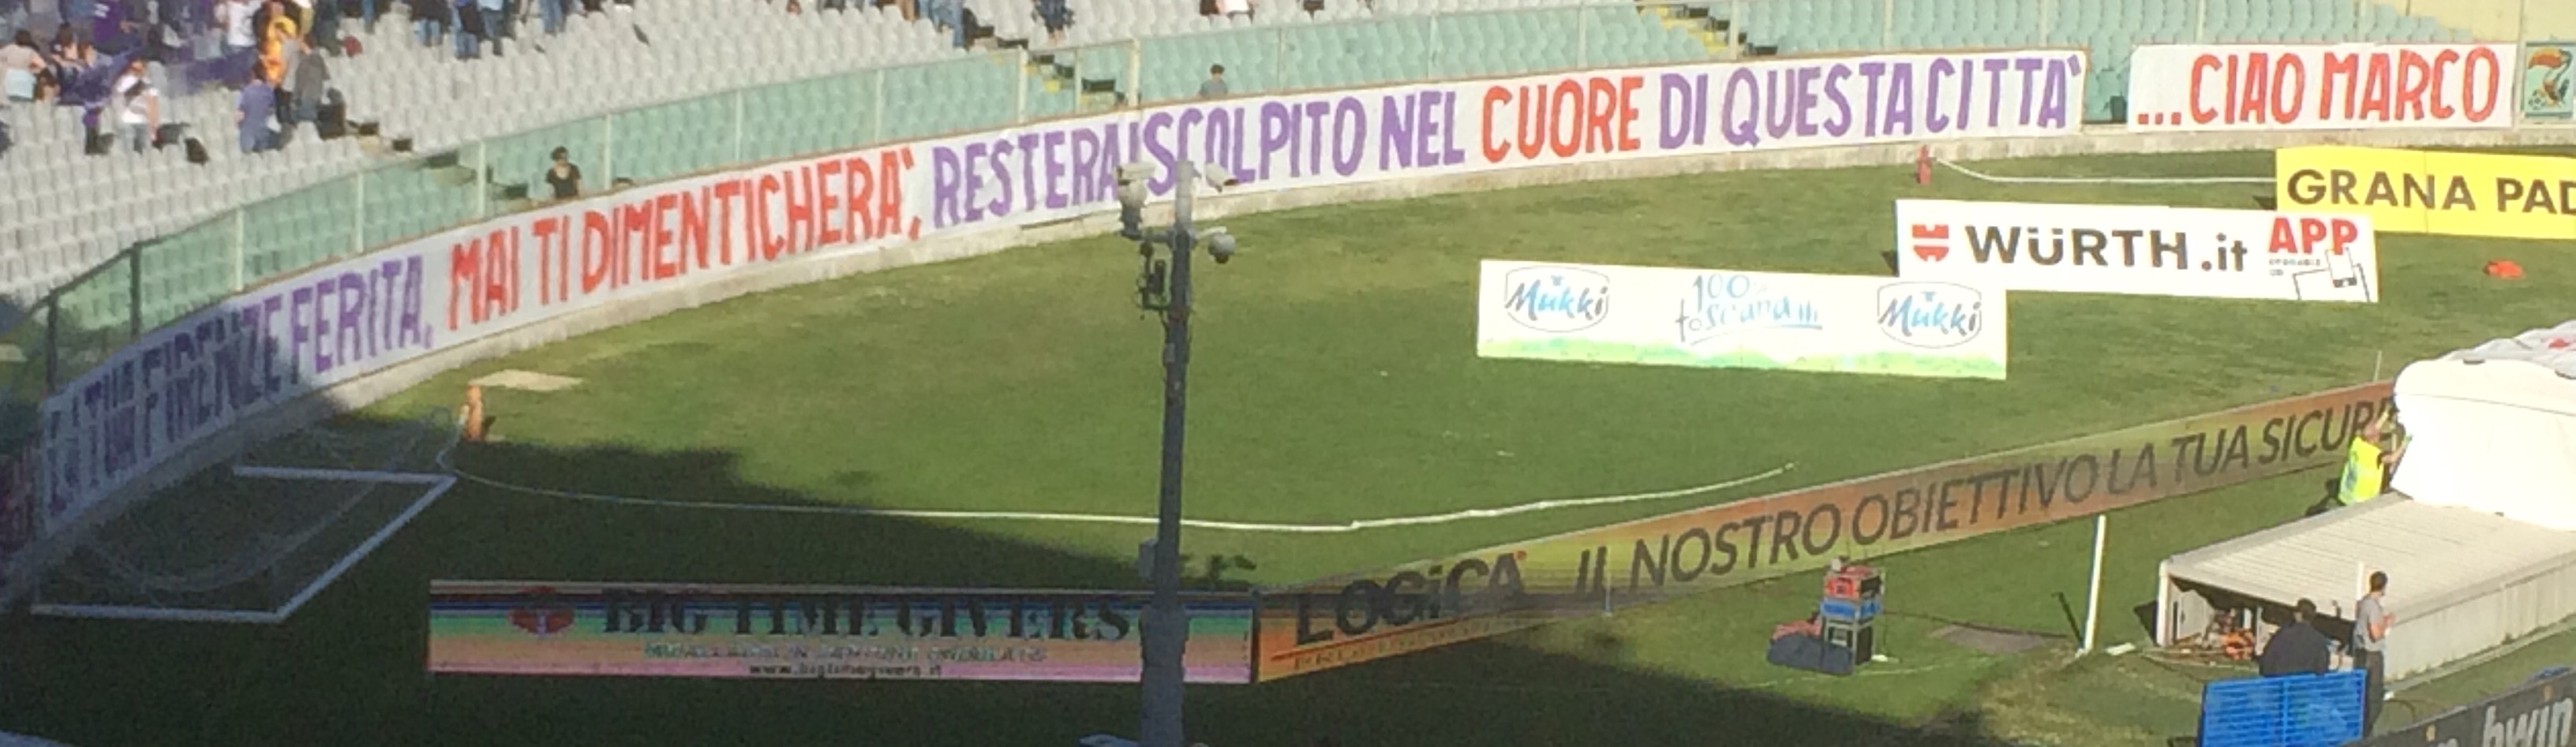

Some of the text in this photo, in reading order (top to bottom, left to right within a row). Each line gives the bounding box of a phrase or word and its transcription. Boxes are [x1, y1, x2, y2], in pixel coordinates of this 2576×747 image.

[2319, 46, 2500, 123] MARCO
[2286, 168, 2476, 211] GRANA
[290, 255, 433, 384] FERITA,
[447, 226, 520, 331] MAI
[533, 215, 571, 305] TI
[1143, 96, 1367, 197] SCOLPITO
[1379, 90, 1466, 172] NEL
[1481, 76, 1644, 164] CUORE
[1659, 73, 1708, 149] DI
[1722, 62, 1914, 148] QUESTA
[2268, 217, 2358, 255] APP
[1505, 282, 1608, 321] Mukki
[1877, 295, 1982, 338] Mukki
[1629, 502, 1841, 592] NOSTRO
[1852, 452, 2099, 546] OBIETTIVO
[2106, 443, 2158, 495] LA
[2169, 424, 2251, 476] TUA
[2483, 697, 2574, 747] bwin
